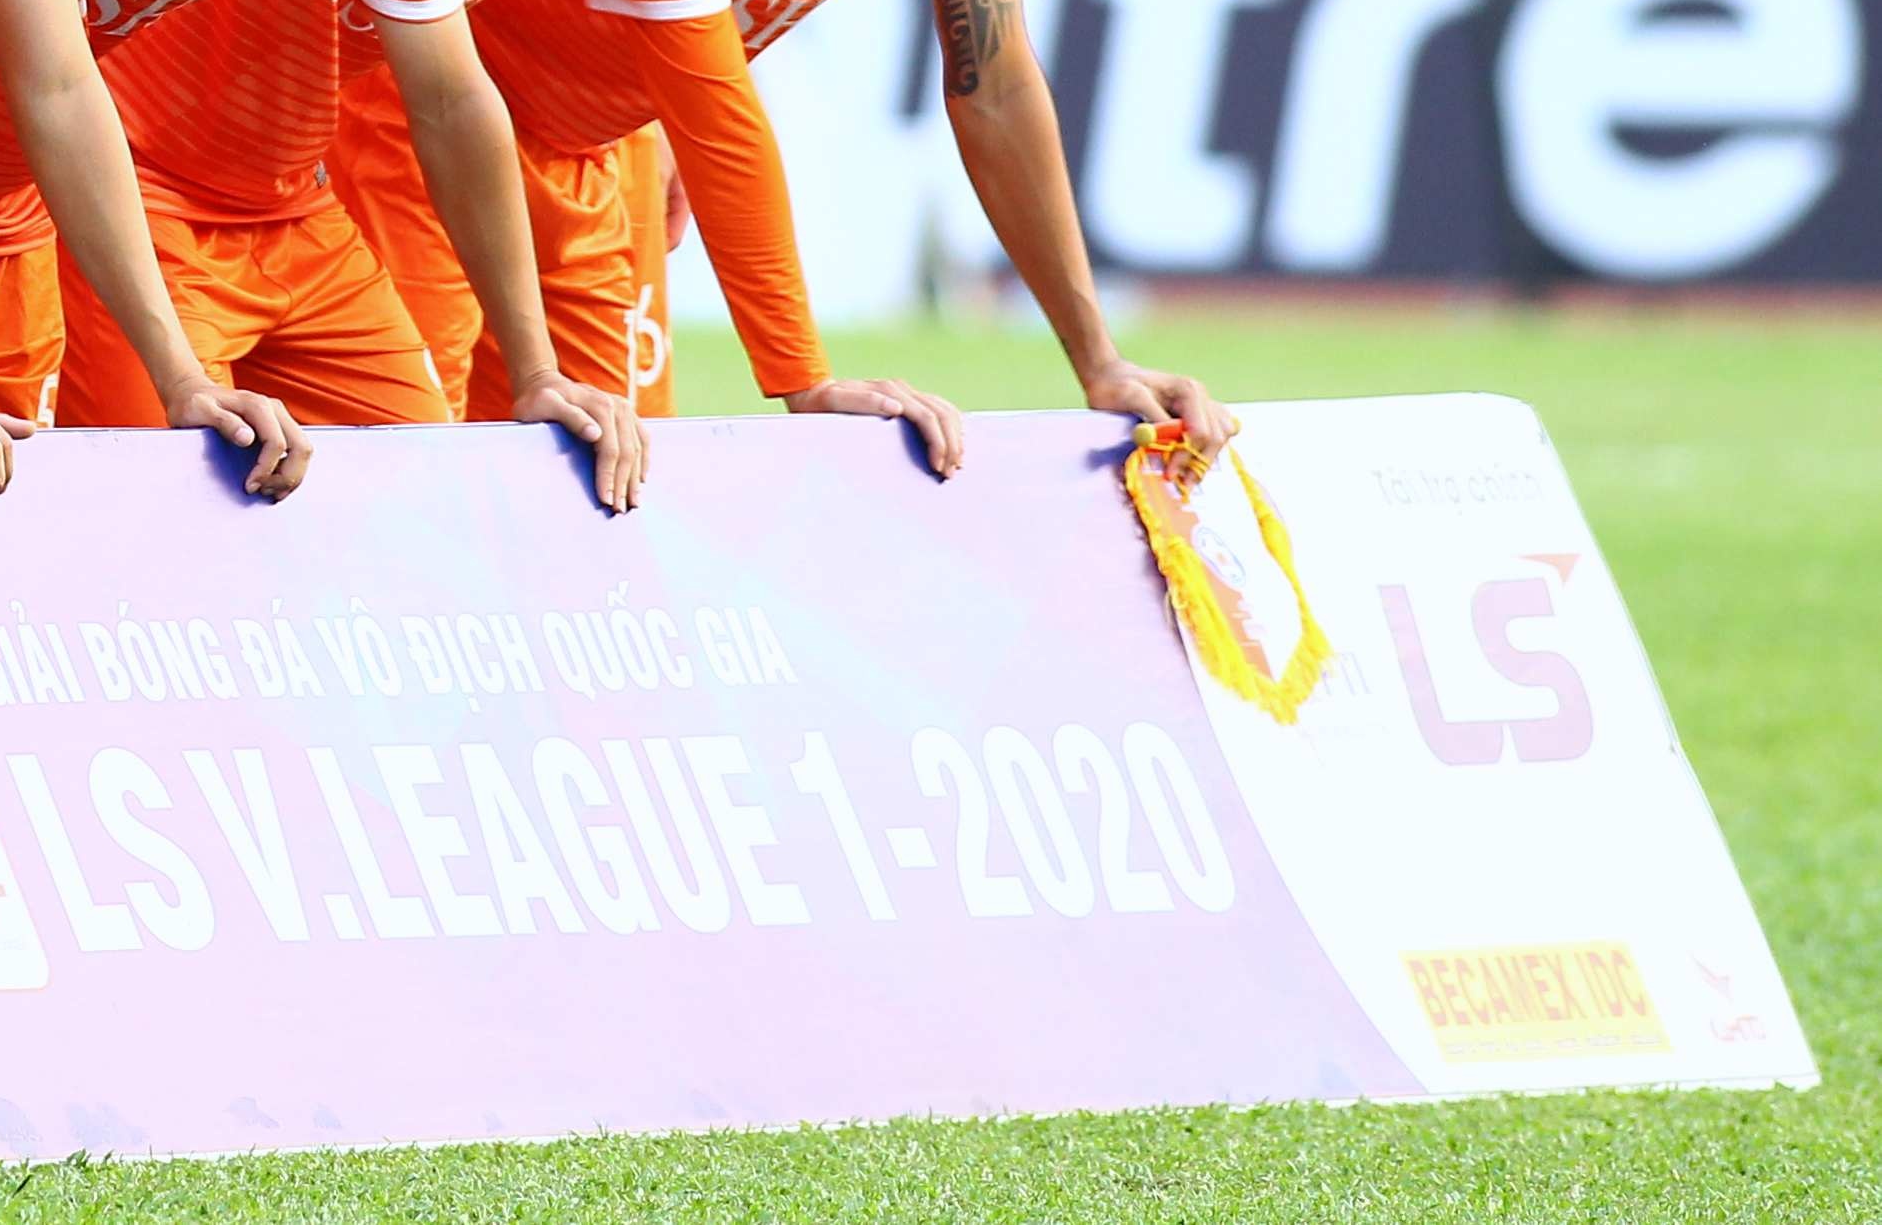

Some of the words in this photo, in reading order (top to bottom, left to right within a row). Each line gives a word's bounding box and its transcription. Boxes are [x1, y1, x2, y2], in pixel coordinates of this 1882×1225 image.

[77, 600, 241, 703] BÓNG
[231, 597, 326, 699] ĐÁ
[313, 595, 405, 698] VÔ
[399, 610, 547, 714] ĐỊCH
[541, 580, 694, 701] QUỐC
[694, 604, 800, 687] GIA
[1376, 576, 1595, 767] LS
[4, 745, 217, 953] LS
[181, 734, 813, 943] V.LEAGUE
[1407, 953, 1588, 1027] BECAMEX
[1574, 948, 1647, 1018] IDC
